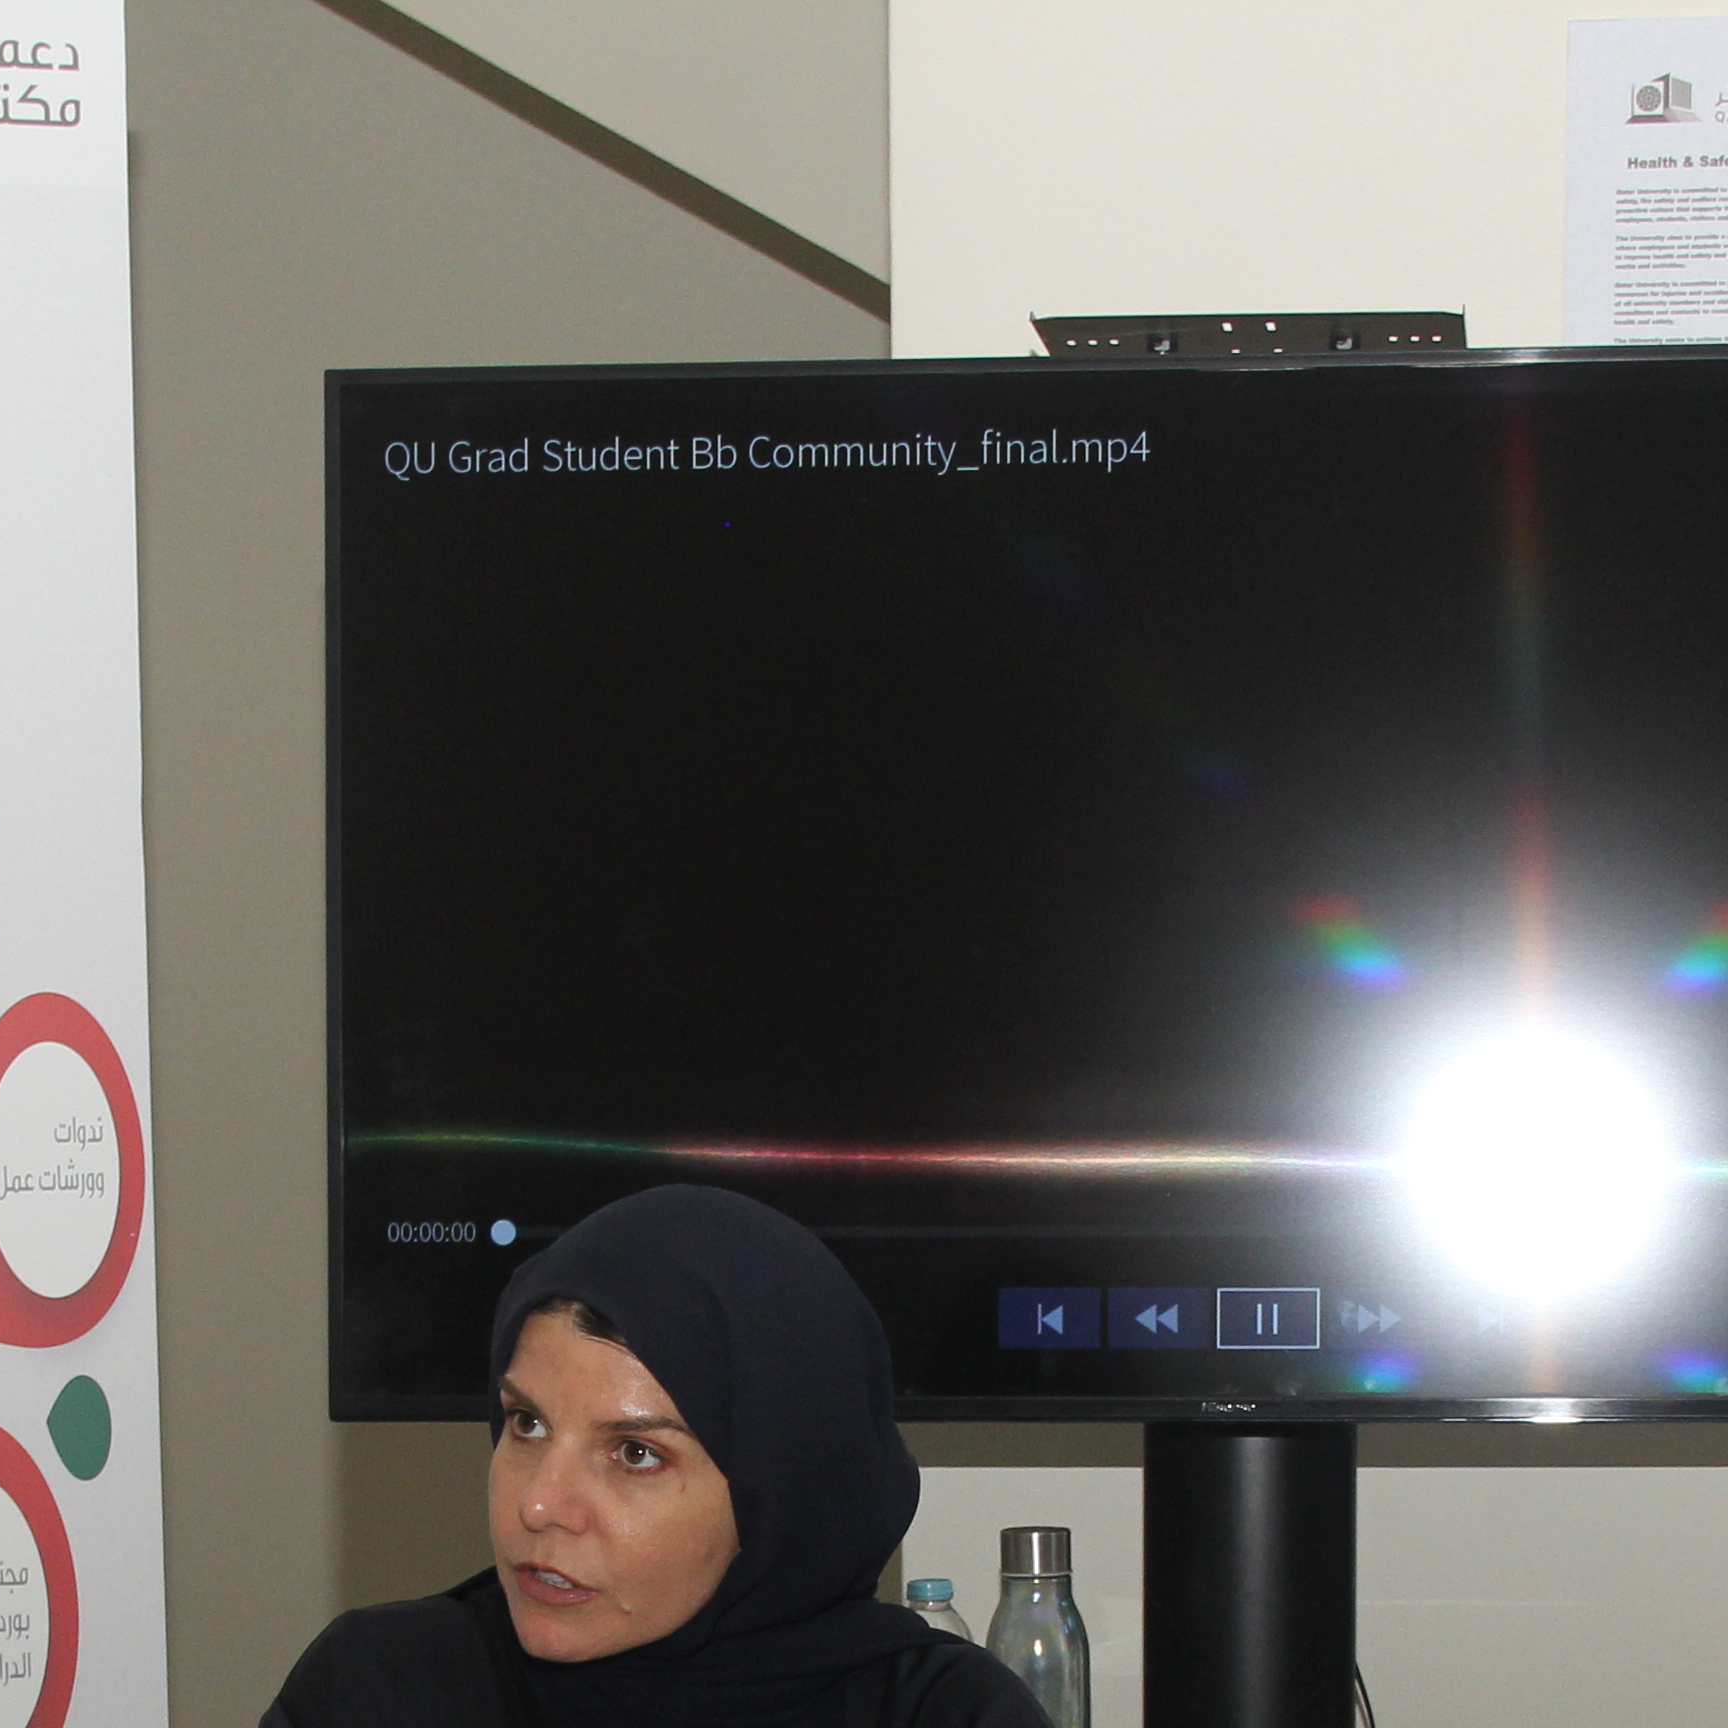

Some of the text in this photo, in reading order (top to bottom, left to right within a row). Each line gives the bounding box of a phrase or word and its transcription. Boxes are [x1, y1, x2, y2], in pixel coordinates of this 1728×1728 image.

[1627, 157, 1678, 170] Health
[1682, 156, 1693, 168] &
[385, 427, 1151, 482] QU Grad Student Bb Community_final.mp4
[54, 1116, 105, 1151] ندوات
[38, 1157, 106, 1199] وورشات
[387, 1220, 477, 1243] 00:00:00
